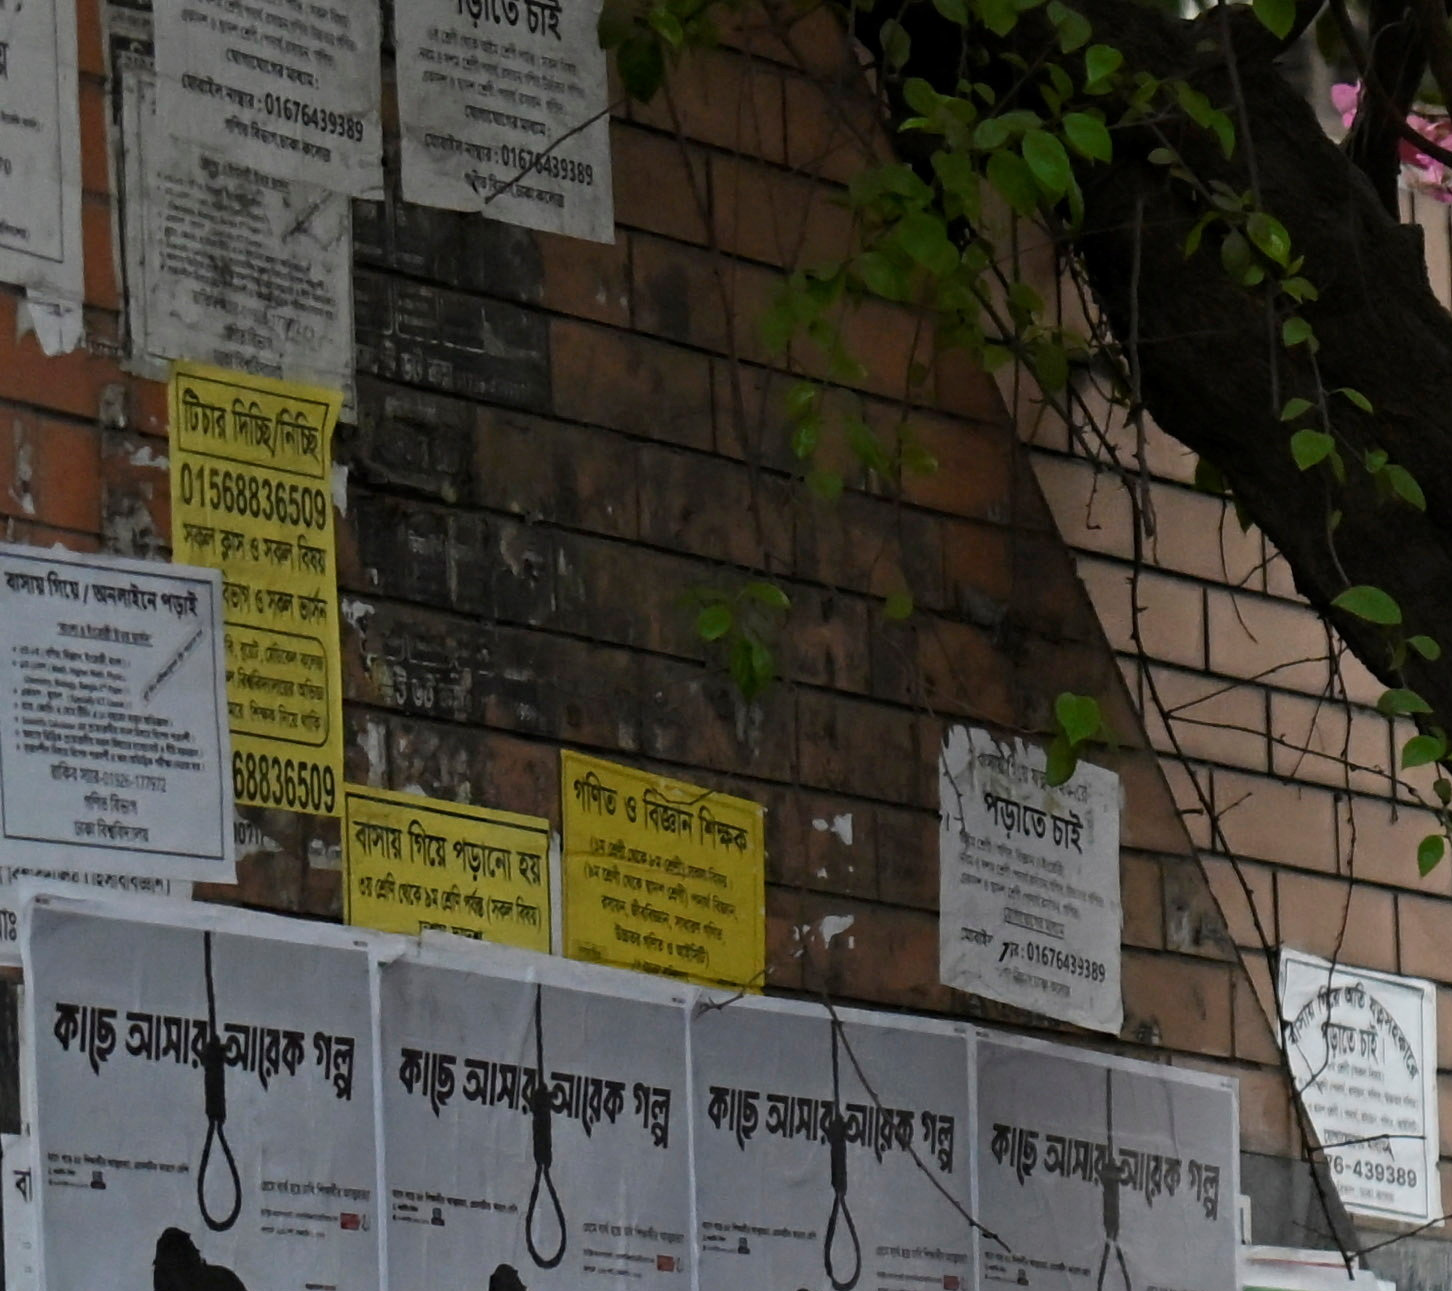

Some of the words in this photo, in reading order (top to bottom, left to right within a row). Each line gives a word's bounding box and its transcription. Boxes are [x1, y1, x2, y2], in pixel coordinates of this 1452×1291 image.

[265, 93, 363, 142] 01676439389
[182, 387, 226, 443] টিচার
[180, 462, 327, 531] 01568836509
[573, 770, 618, 817] গণিত
[625, 795, 637, 824] ও
[642, 787, 694, 844] বিজ্ঞান
[983, 791, 1047, 840] পড়াতে
[1051, 809, 1083, 855] চাই
[353, 819, 402, 860] বাসায়
[408, 818, 447, 869] গিয়ে
[453, 836, 511, 883] পড়ানো
[515, 850, 541, 887] হয়
[54, 1002, 117, 1076] কাছে
[125, 1012, 209, 1070] আসার
[223, 1022, 306, 1093] আরেক
[313, 1031, 355, 1101] গল্প
[399, 1047, 457, 1119] কাছে
[462, 1058, 538, 1116] আসার
[550, 1071, 626, 1139] আরেক
[632, 1082, 673, 1150] গল্প
[708, 1085, 760, 1152] কাছে
[765, 1094, 834, 1146] আসার
[846, 1103, 915, 1165] আরেক
[921, 1110, 955, 1175] গল্প
[991, 1123, 1039, 1187] কাছে
[1044, 1134, 1108, 1186] আসার
[1118, 1148, 1182, 1209] আরেক
[1188, 1158, 1221, 1222] গল্প
